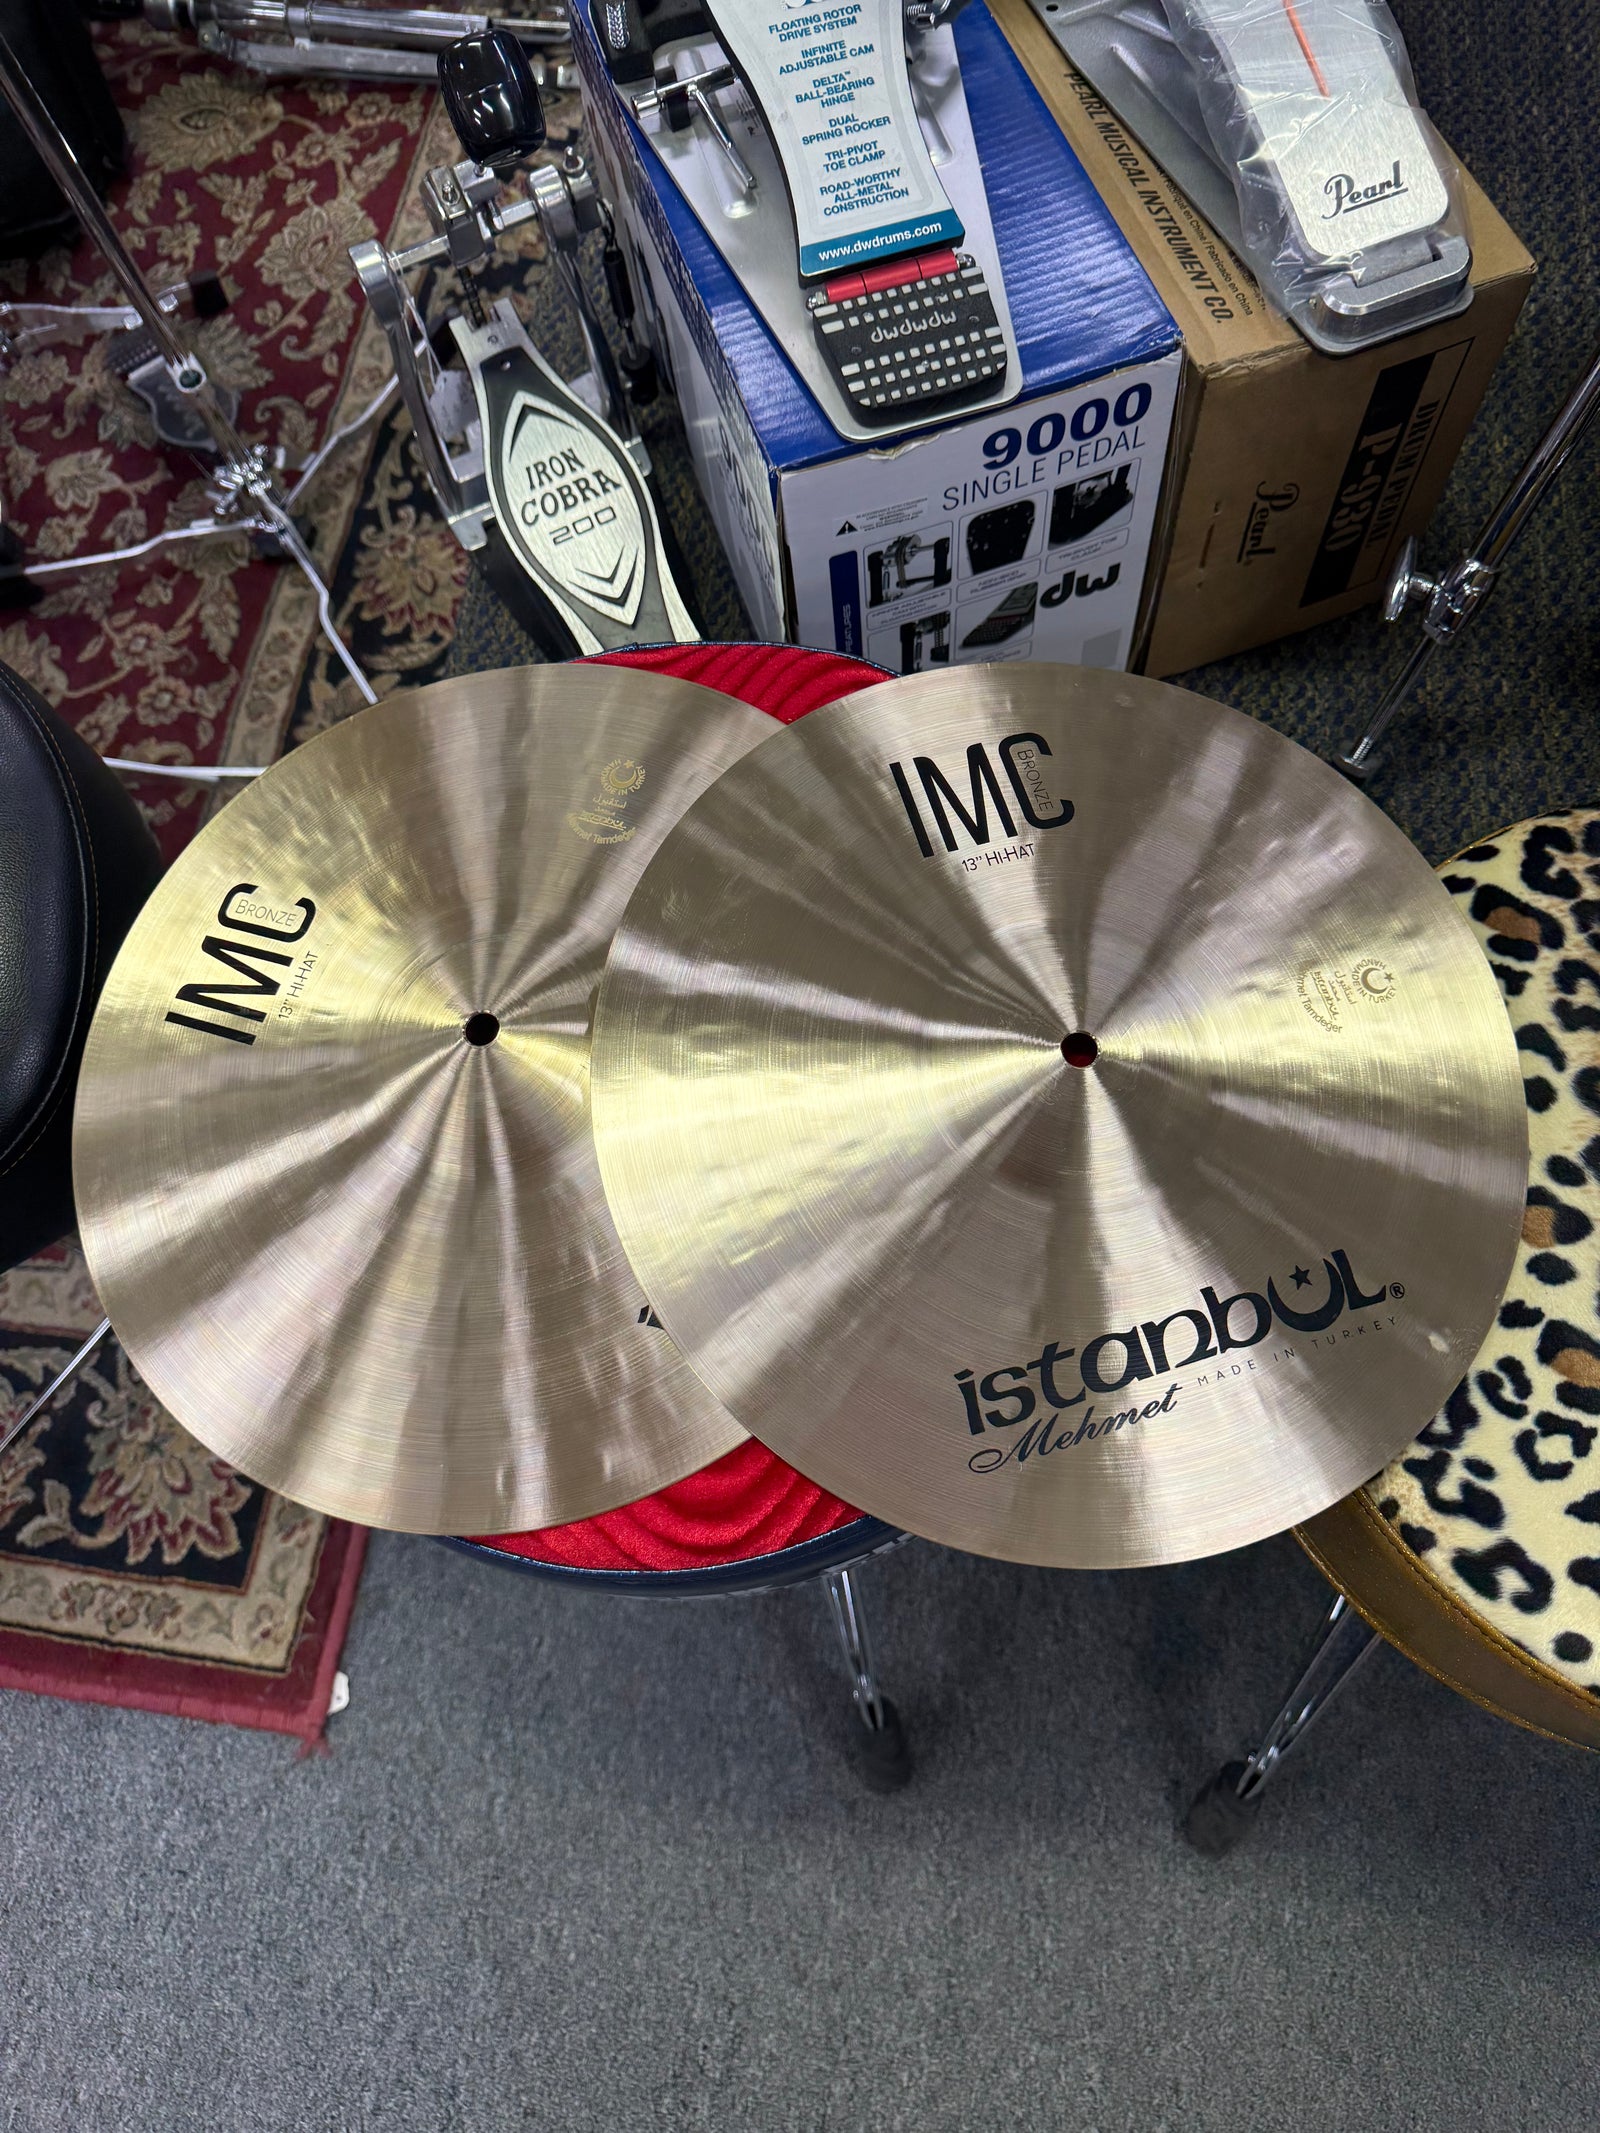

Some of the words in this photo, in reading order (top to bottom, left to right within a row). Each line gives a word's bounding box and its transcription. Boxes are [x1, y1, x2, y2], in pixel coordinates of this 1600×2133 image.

[769, 15, 821, 34] FLOATING
[824, 4, 862, 20] ROTOR
[779, 27, 812, 43] DRIVE
[814, 15, 858, 34] SYSTEM
[779, 50, 847, 75] ADJUSTABLE
[850, 44, 874, 57] CAM
[801, 40, 847, 59] INFINITE
[795, 76, 875, 104] BALL-BEARING
[821, 92, 855, 108] HINGE
[802, 129, 843, 145] SPRING
[845, 116, 891, 135] ROCKER
[828, 113, 859, 128] DUAL
[823, 160, 846, 173] TOE
[848, 150, 886, 166] CLAMP
[825, 140, 878, 162] TRI-PIVOT
[820, 167, 901, 196] ROAD-WORTHY
[834, 182, 893, 203] ALL-METAL
[1064, 71, 1104, 120] PEARL
[1095, 113, 1150, 187] MUSICAL
[1138, 189, 1219, 294] INSTRUMENT
[1204, 296, 1234, 324] CO.
[1321, 159, 1408, 219] Pearl
[824, 187, 909, 216] CONSTRUCTION
[818, 222, 942, 261] www.dwdrums.com
[1183, 207, 1193, 222] en
[1190, 218, 1207, 245] Chine
[1207, 245, 1232, 282] Fabricado
[1228, 278, 1239, 292] en
[1235, 290, 1253, 316] China
[982, 382, 1152, 471] 9000
[1394, 400, 1440, 471] DRUM
[525, 448, 585, 490] IRON
[942, 456, 1047, 511] SINGLE
[1057, 426, 1145, 476] PEDAL
[1324, 422, 1403, 552] P-930
[520, 469, 622, 527] COBRA
[550, 506, 617, 545] 200
[1240, 480, 1300, 564] Pearl
[1039, 562, 1122, 608] dw
[889, 732, 1075, 859] IMC
[1017, 749, 1053, 812] BRONZE
[985, 843, 1035, 867] HI-HAT
[235, 899, 297, 926] BRONZE
[165, 883, 316, 1046] IMC
[286, 950, 319, 998] HI-HAT
[1351, 958, 1387, 987] HANDMADE
[1357, 987, 1368, 997] IN
[1369, 985, 1397, 1004] TURKEY
[1197, 1358, 1257, 1387] MADE
[1274, 1347, 1296, 1363] IN
[1311, 1315, 1398, 1348] TURKEY
[967, 1382, 1183, 1474] Mehmet
